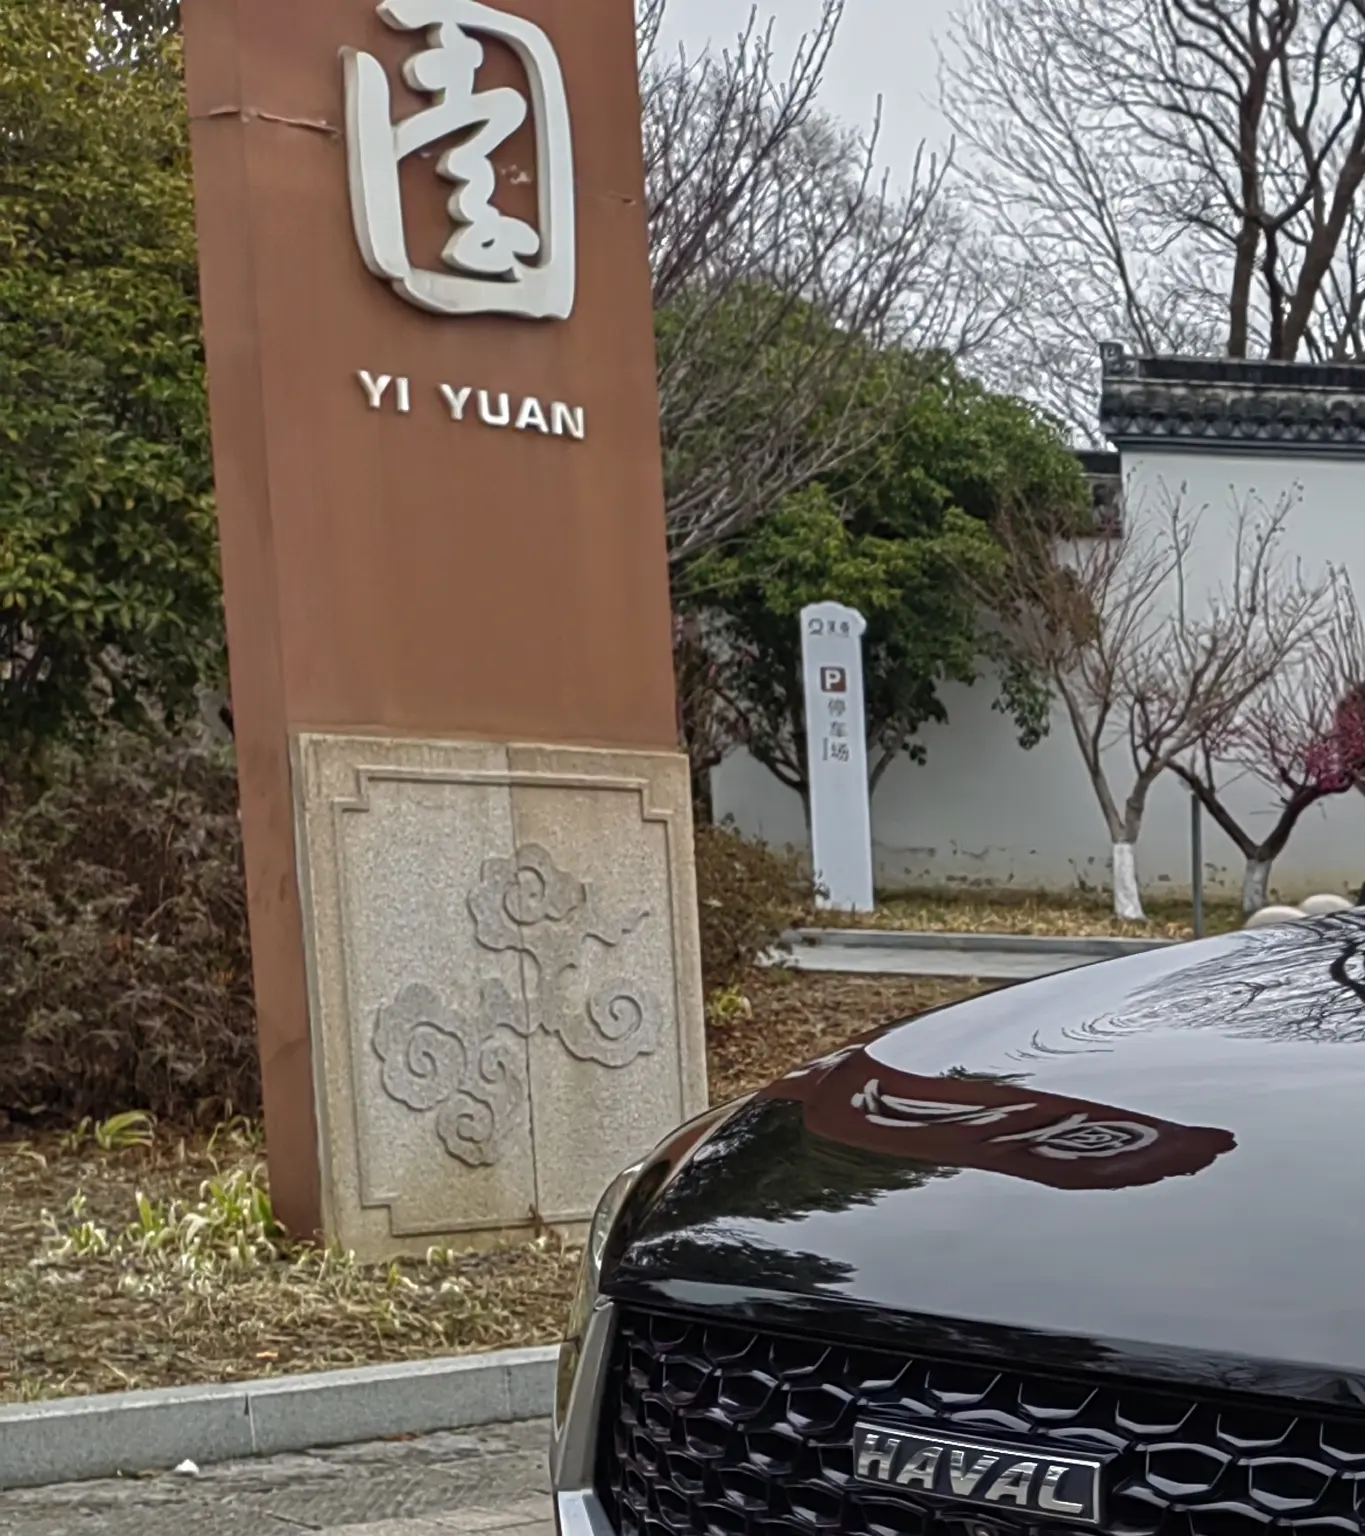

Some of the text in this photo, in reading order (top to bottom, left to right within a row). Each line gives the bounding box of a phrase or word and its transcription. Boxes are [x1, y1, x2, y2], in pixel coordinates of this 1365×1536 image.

[357, 369, 585, 440] YI YUAN
[828, 697, 849, 762] 停车场
[857, 1433, 1084, 1514] HAVAL
